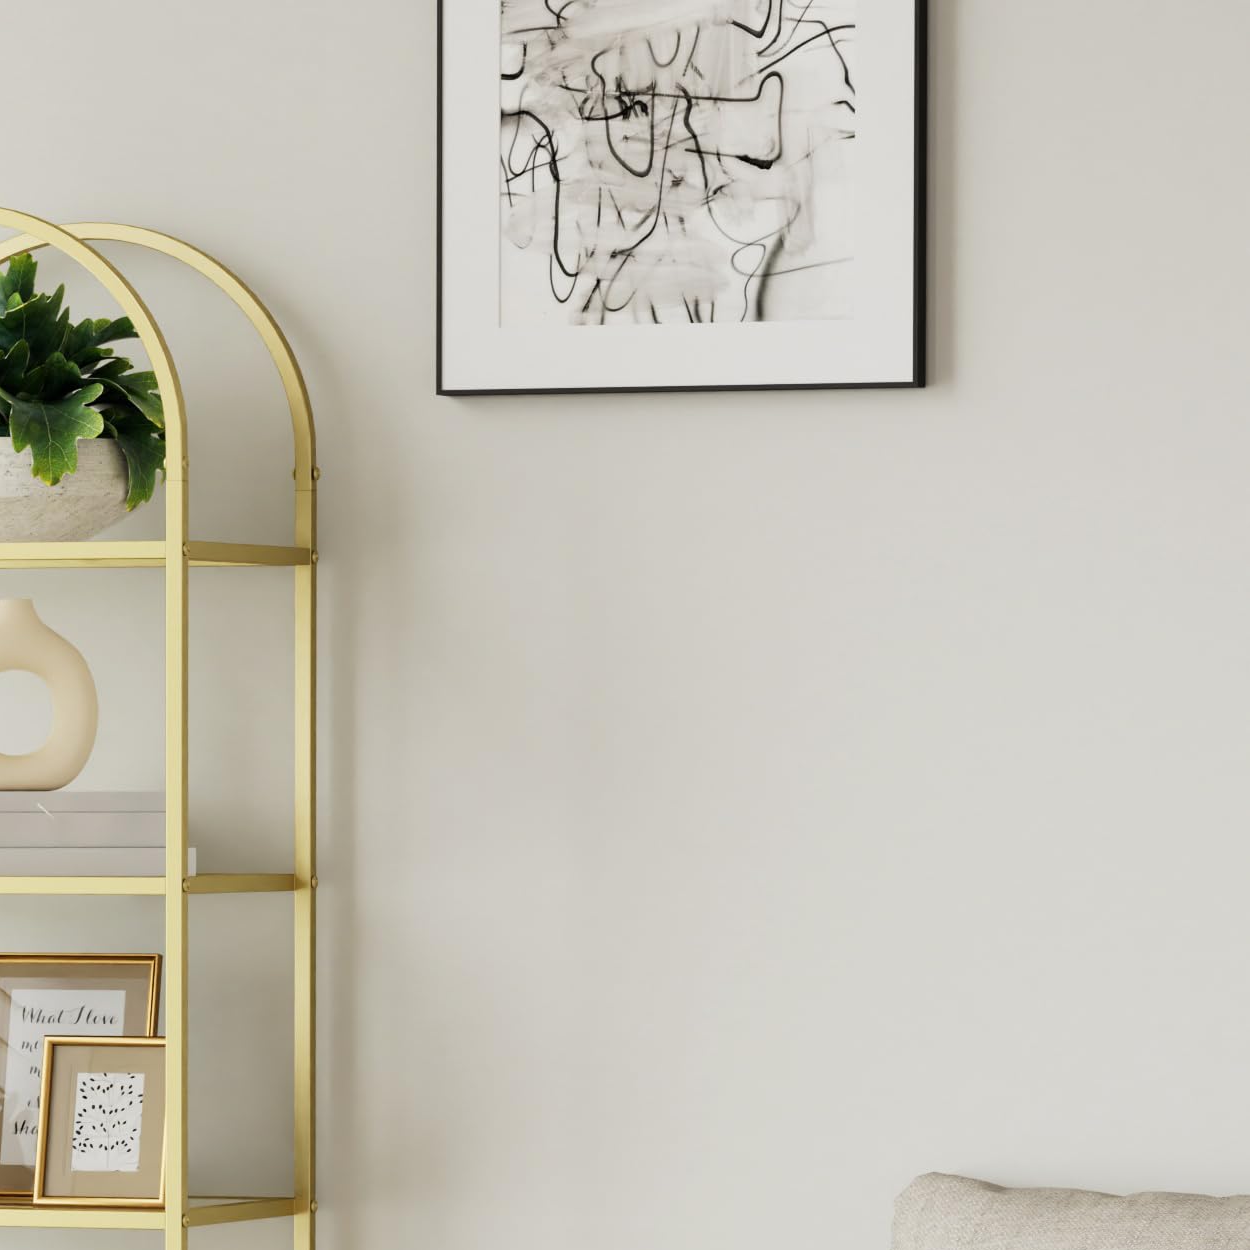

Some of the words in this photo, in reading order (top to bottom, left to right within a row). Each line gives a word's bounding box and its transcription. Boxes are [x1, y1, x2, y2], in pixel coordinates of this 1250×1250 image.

[21, 1007, 64, 1025] What
[72, 1005, 86, 1025] I
[86, 1009, 118, 1025] love
